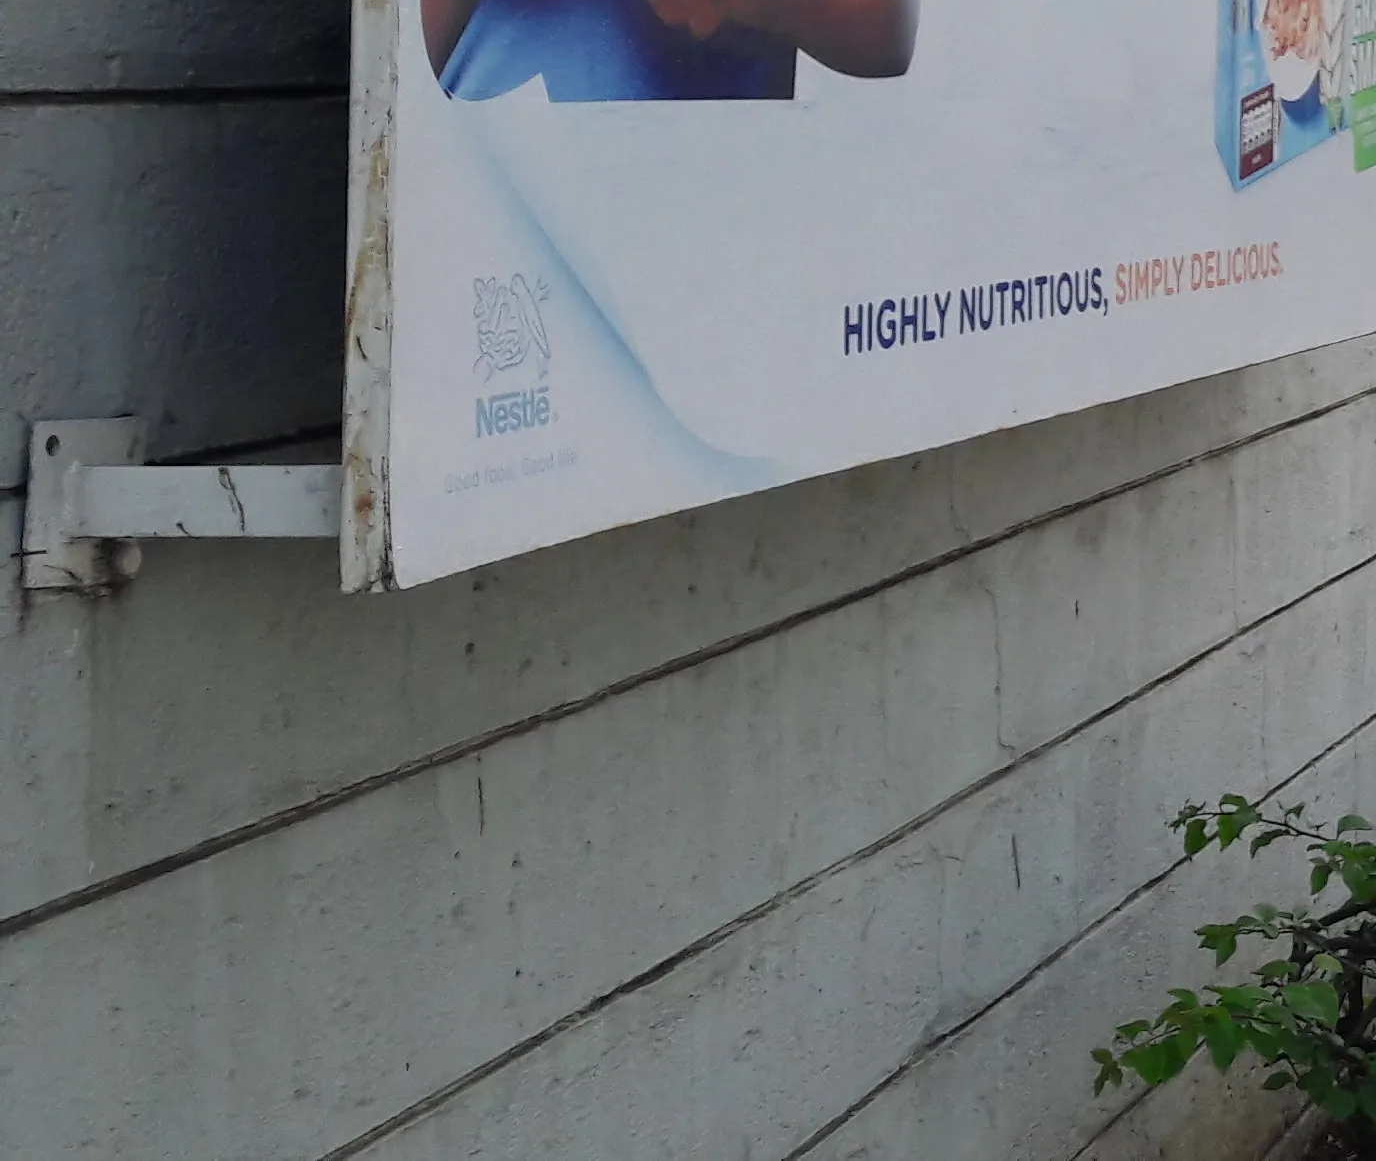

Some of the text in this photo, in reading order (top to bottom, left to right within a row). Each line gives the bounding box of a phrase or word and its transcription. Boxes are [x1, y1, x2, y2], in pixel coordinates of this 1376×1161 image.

[844, 241, 1285, 356] HIGHLY NUTRITIOUS, SIMPLY DELICIOUS.
